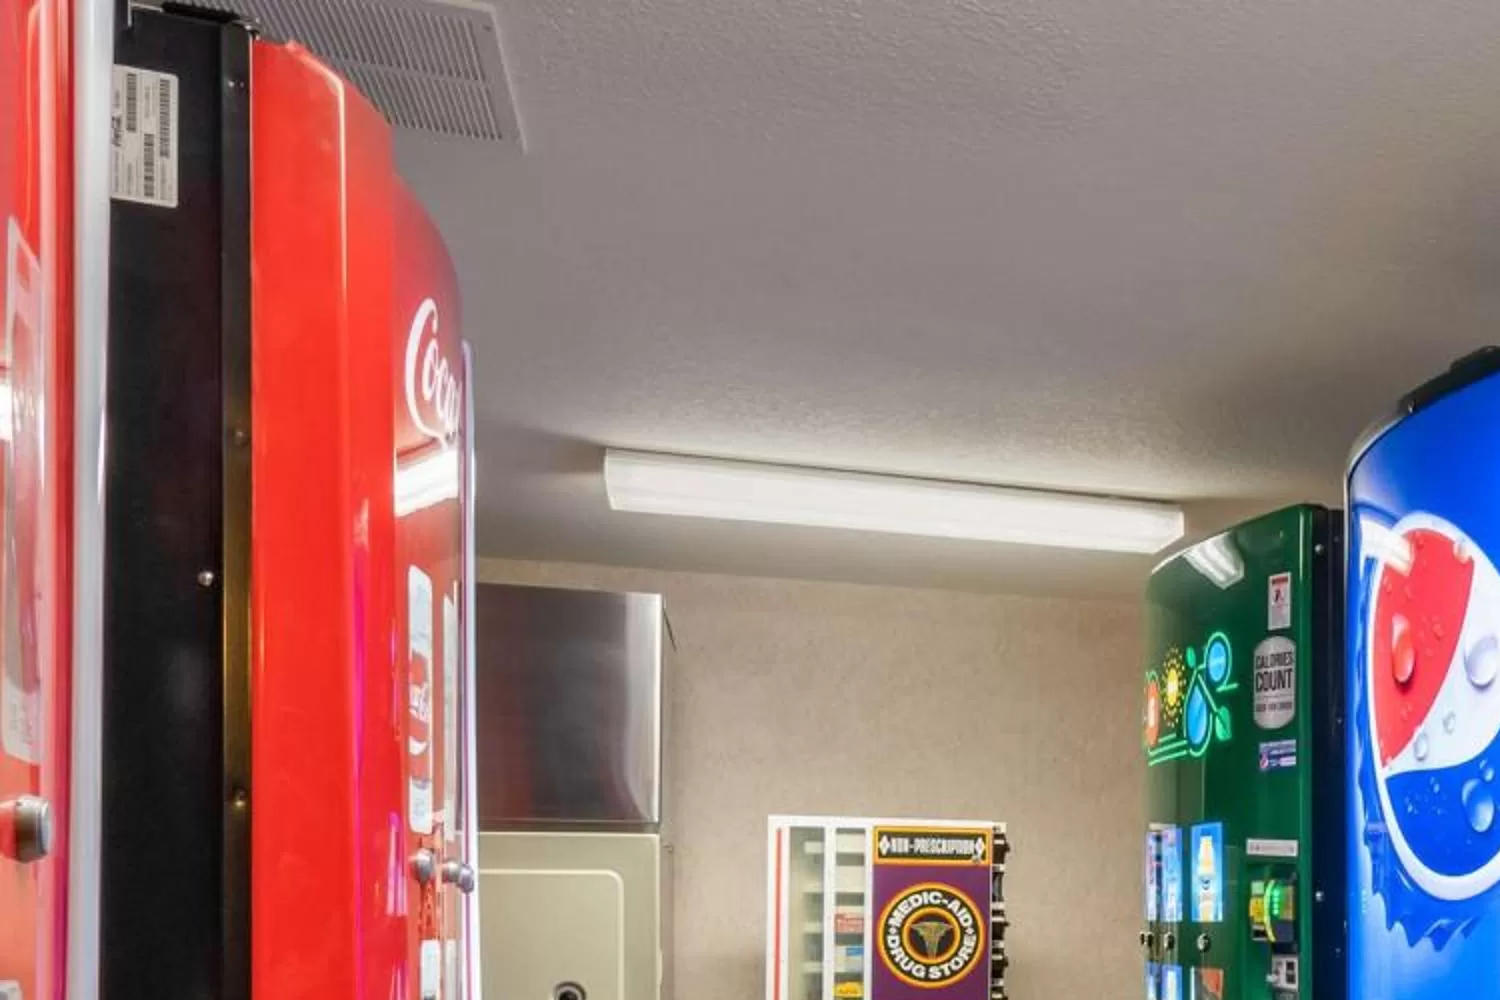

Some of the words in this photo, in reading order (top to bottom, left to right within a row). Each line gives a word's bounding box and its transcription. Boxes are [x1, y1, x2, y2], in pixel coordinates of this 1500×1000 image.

[1255, 652, 1293, 670] CALORIES
[1255, 668, 1293, 692] COUNT
[888, 891, 975, 929] MEDIC-AID
[886, 935, 927, 979] DRUG
[927, 933, 977, 979] STORE
